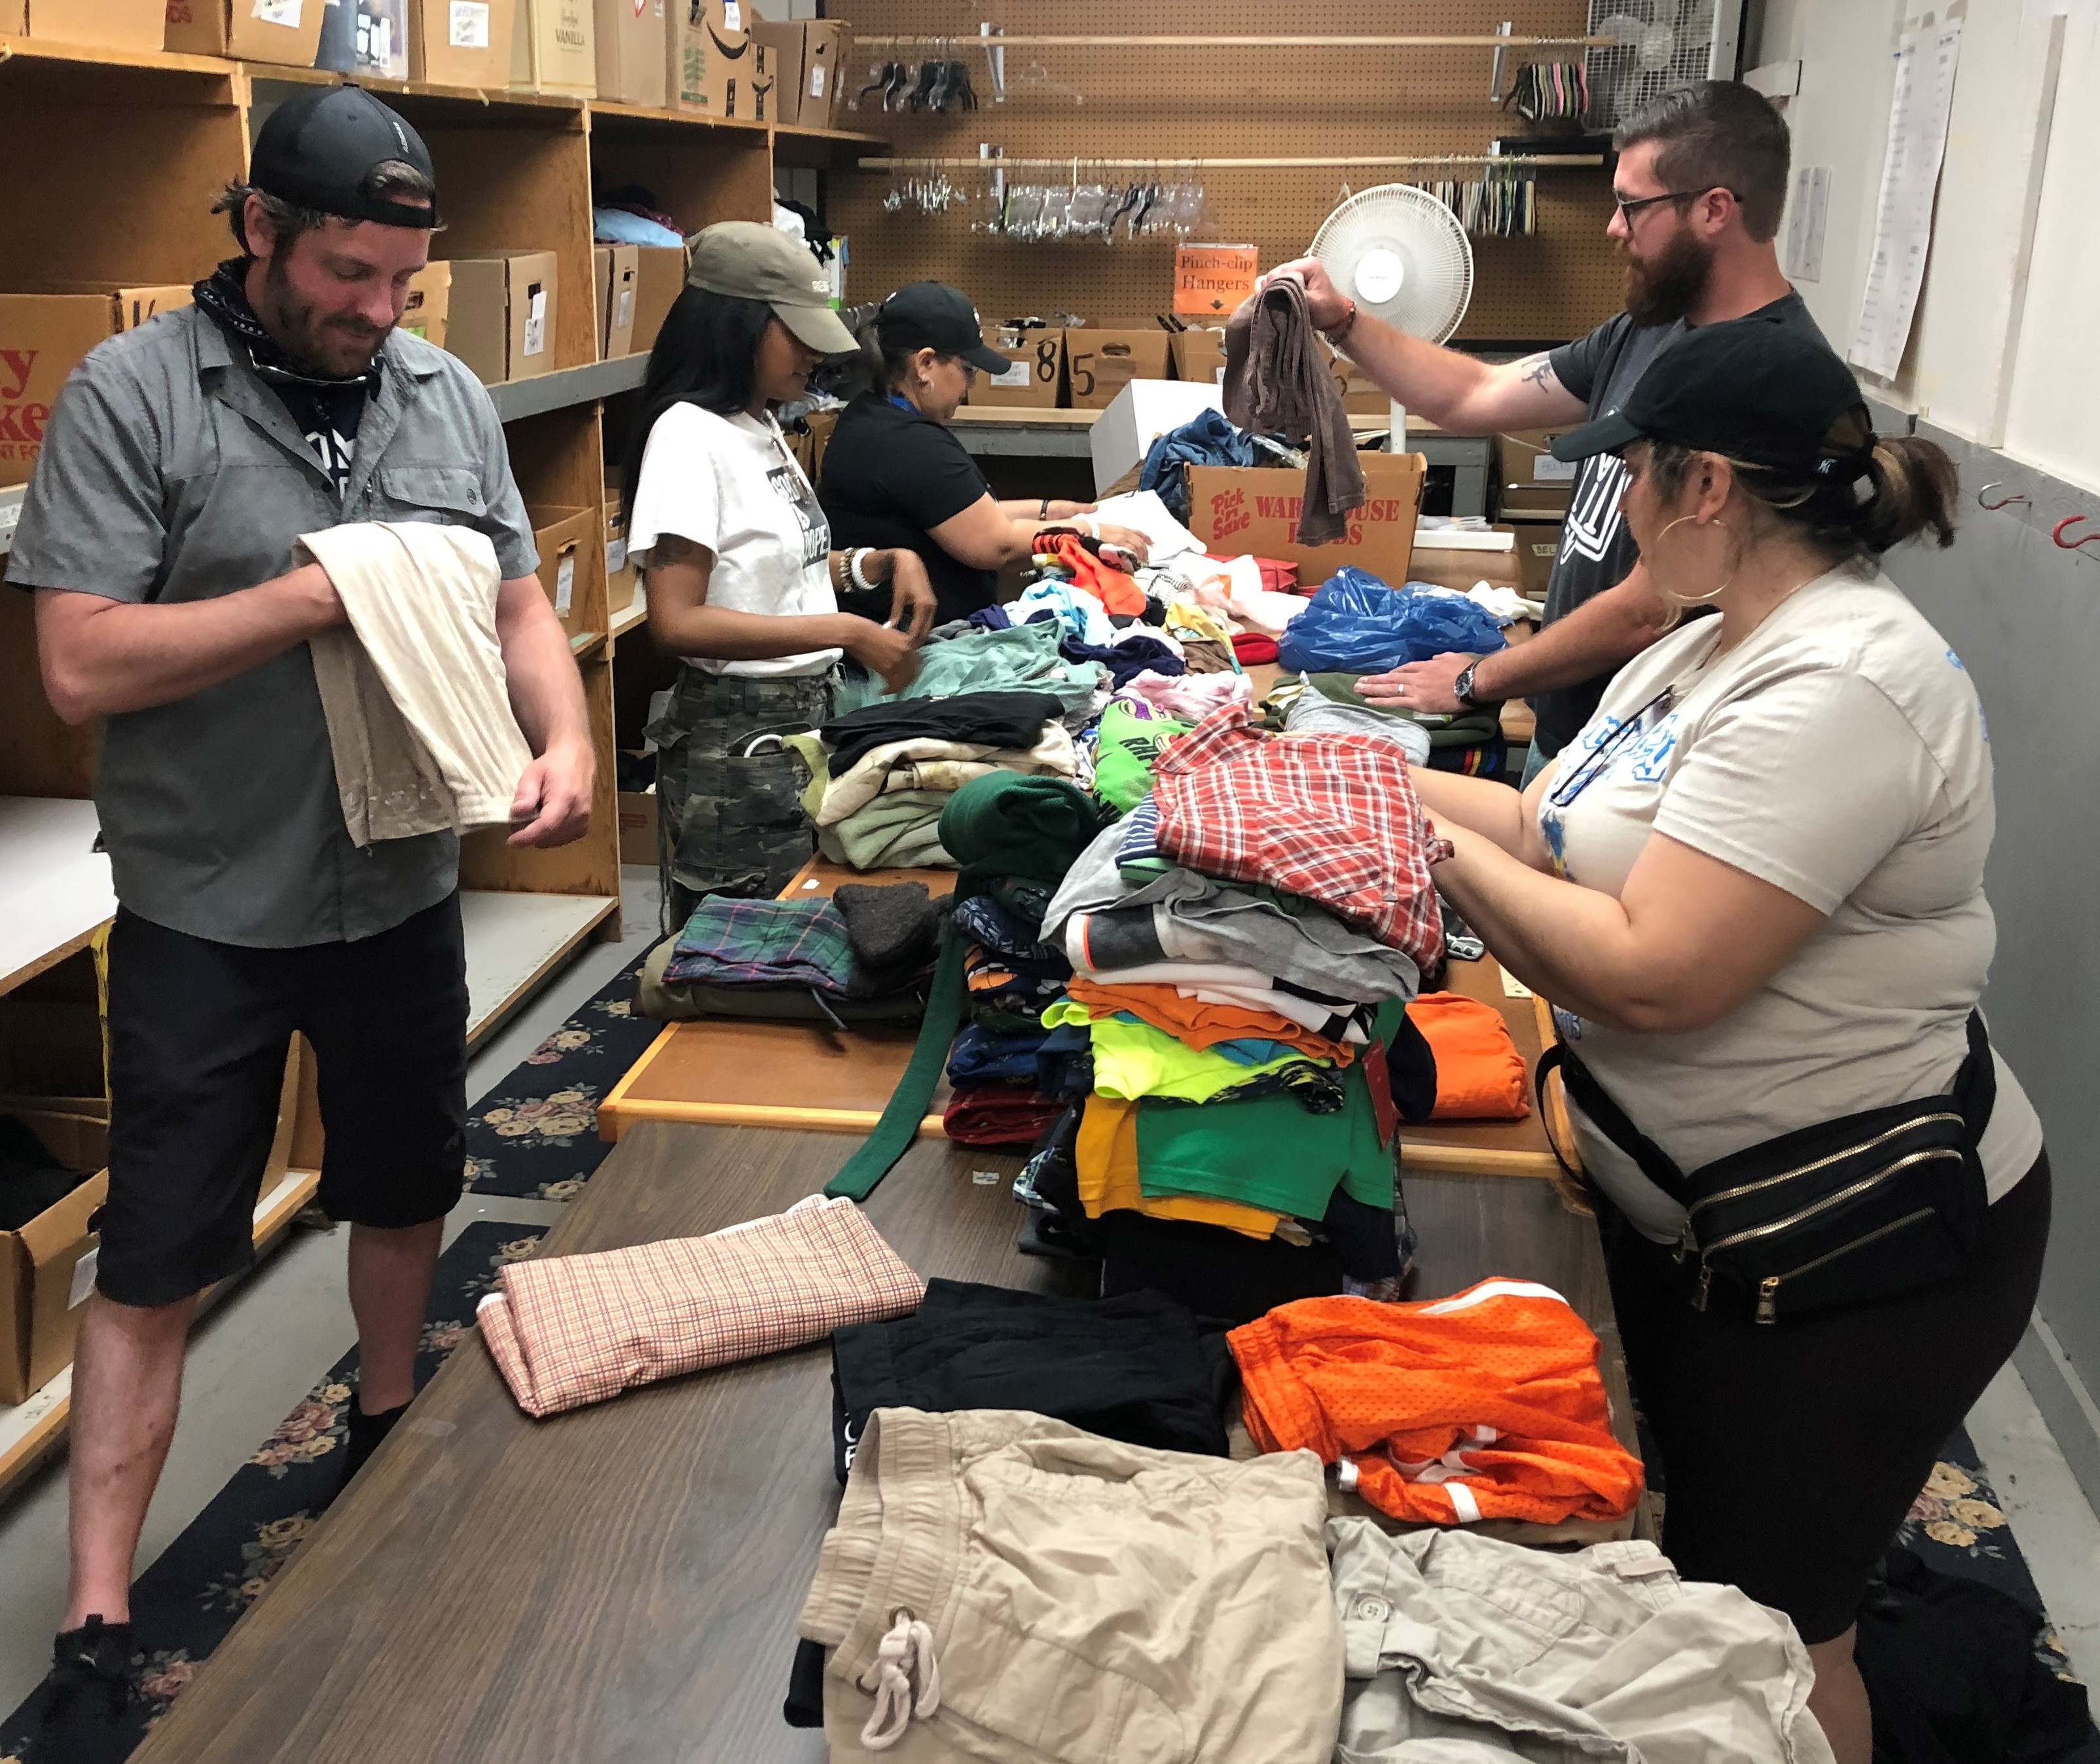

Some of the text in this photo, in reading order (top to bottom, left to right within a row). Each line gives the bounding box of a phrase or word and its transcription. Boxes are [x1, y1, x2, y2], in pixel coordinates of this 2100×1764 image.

[555, 29, 585, 46] VANILLA
[1181, 255, 1253, 272] Pinch-clip
[1183, 275, 1250, 293] Hangers
[1037, 339, 1057, 382] 8
[1074, 354, 1095, 396] 5
[1211, 488, 1244, 515] Pick
[1256, 496, 1400, 521] WARUSE
[1213, 511, 1250, 540] Save
[1536, 545, 1557, 554] BEL
